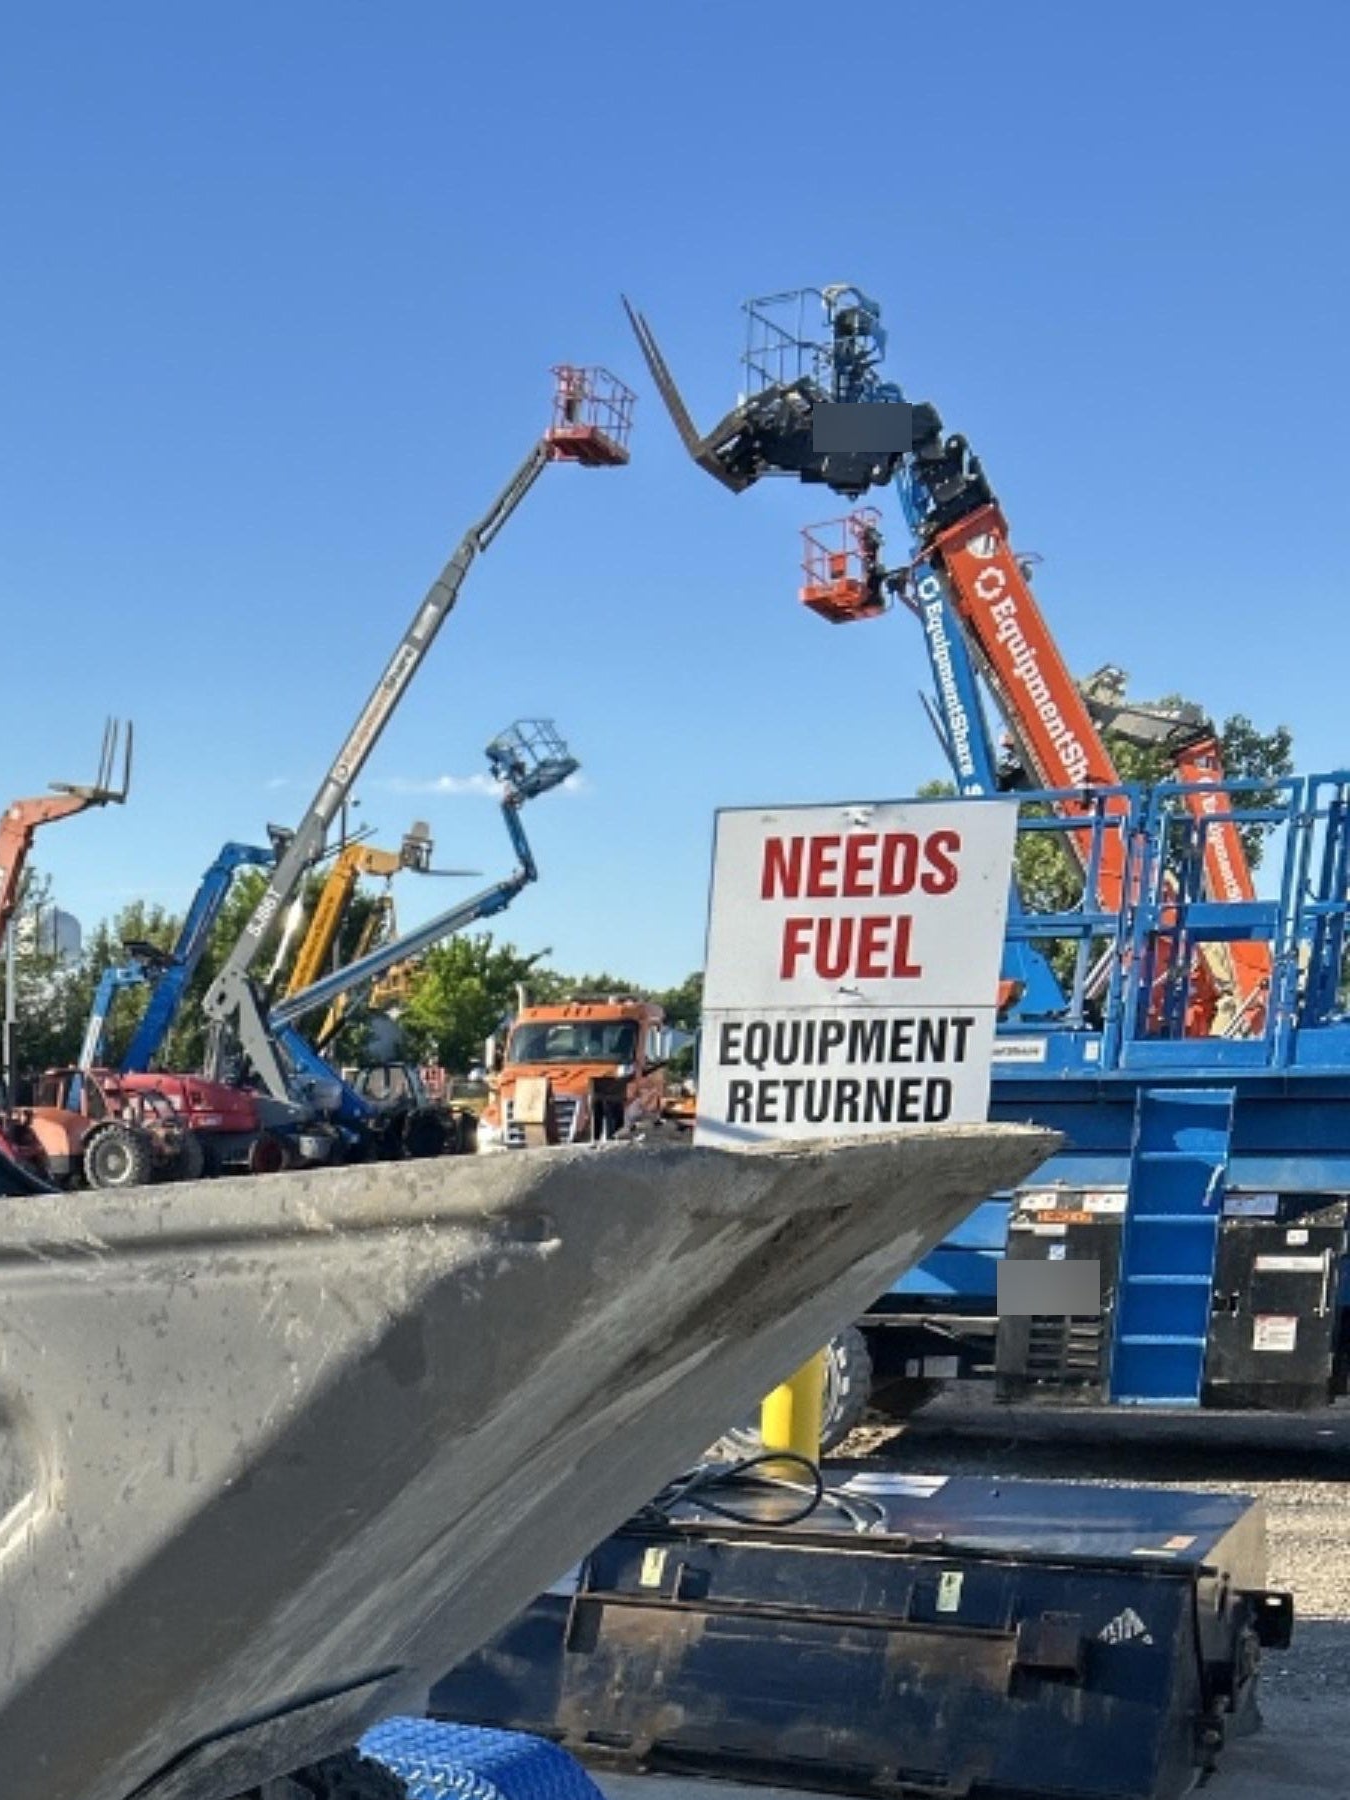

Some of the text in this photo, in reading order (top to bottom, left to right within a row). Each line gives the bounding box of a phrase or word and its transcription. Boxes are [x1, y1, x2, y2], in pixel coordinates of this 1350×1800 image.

[924, 600, 975, 776] EquipmentShare
[990, 596, 1091, 788] EquipmentSh
[760, 830, 961, 900] NEEDS
[780, 914, 922, 980] FUEL
[718, 1016, 976, 1071] EQUIPMENT
[726, 1077, 954, 1123] RETURNED
